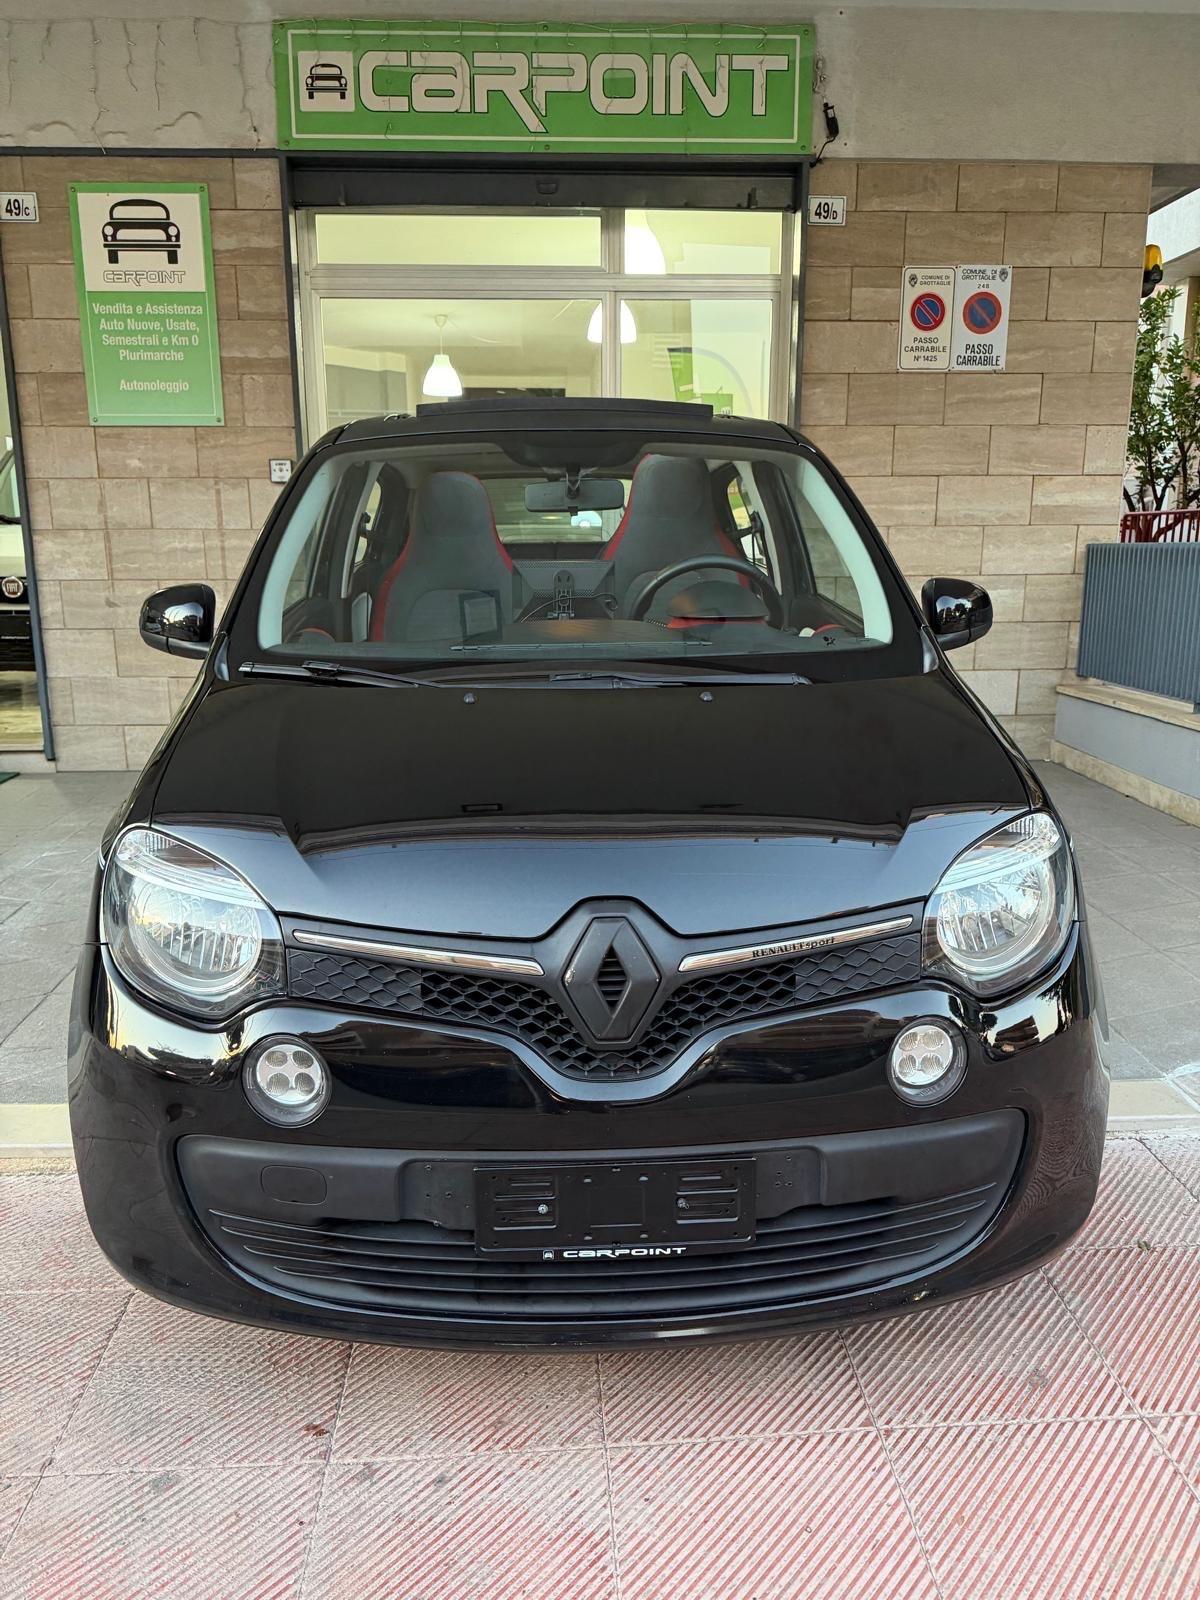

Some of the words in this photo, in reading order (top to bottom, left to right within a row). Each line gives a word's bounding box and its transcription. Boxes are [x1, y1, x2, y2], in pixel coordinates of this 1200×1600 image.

[92, 303, 133, 314] Vendita
[136, 306, 142, 314] e
[145, 303, 203, 315] Assistenza
[99, 318, 124, 330] Auto
[127, 318, 164, 332] Nuove,
[166, 318, 200, 333] Usate,
[102, 334, 159, 346] Semestrali
[162, 337, 168, 346] e
[171, 335, 189, 346] Km
[191, 335, 199, 346] 0
[119, 349, 184, 361] Plurimarche
[904, 345, 947, 353] CARRABILE
[965, 343, 994, 355] PASSO
[956, 355, 1001, 367] CARRABILE
[119, 379, 189, 392] Autonoleggio
